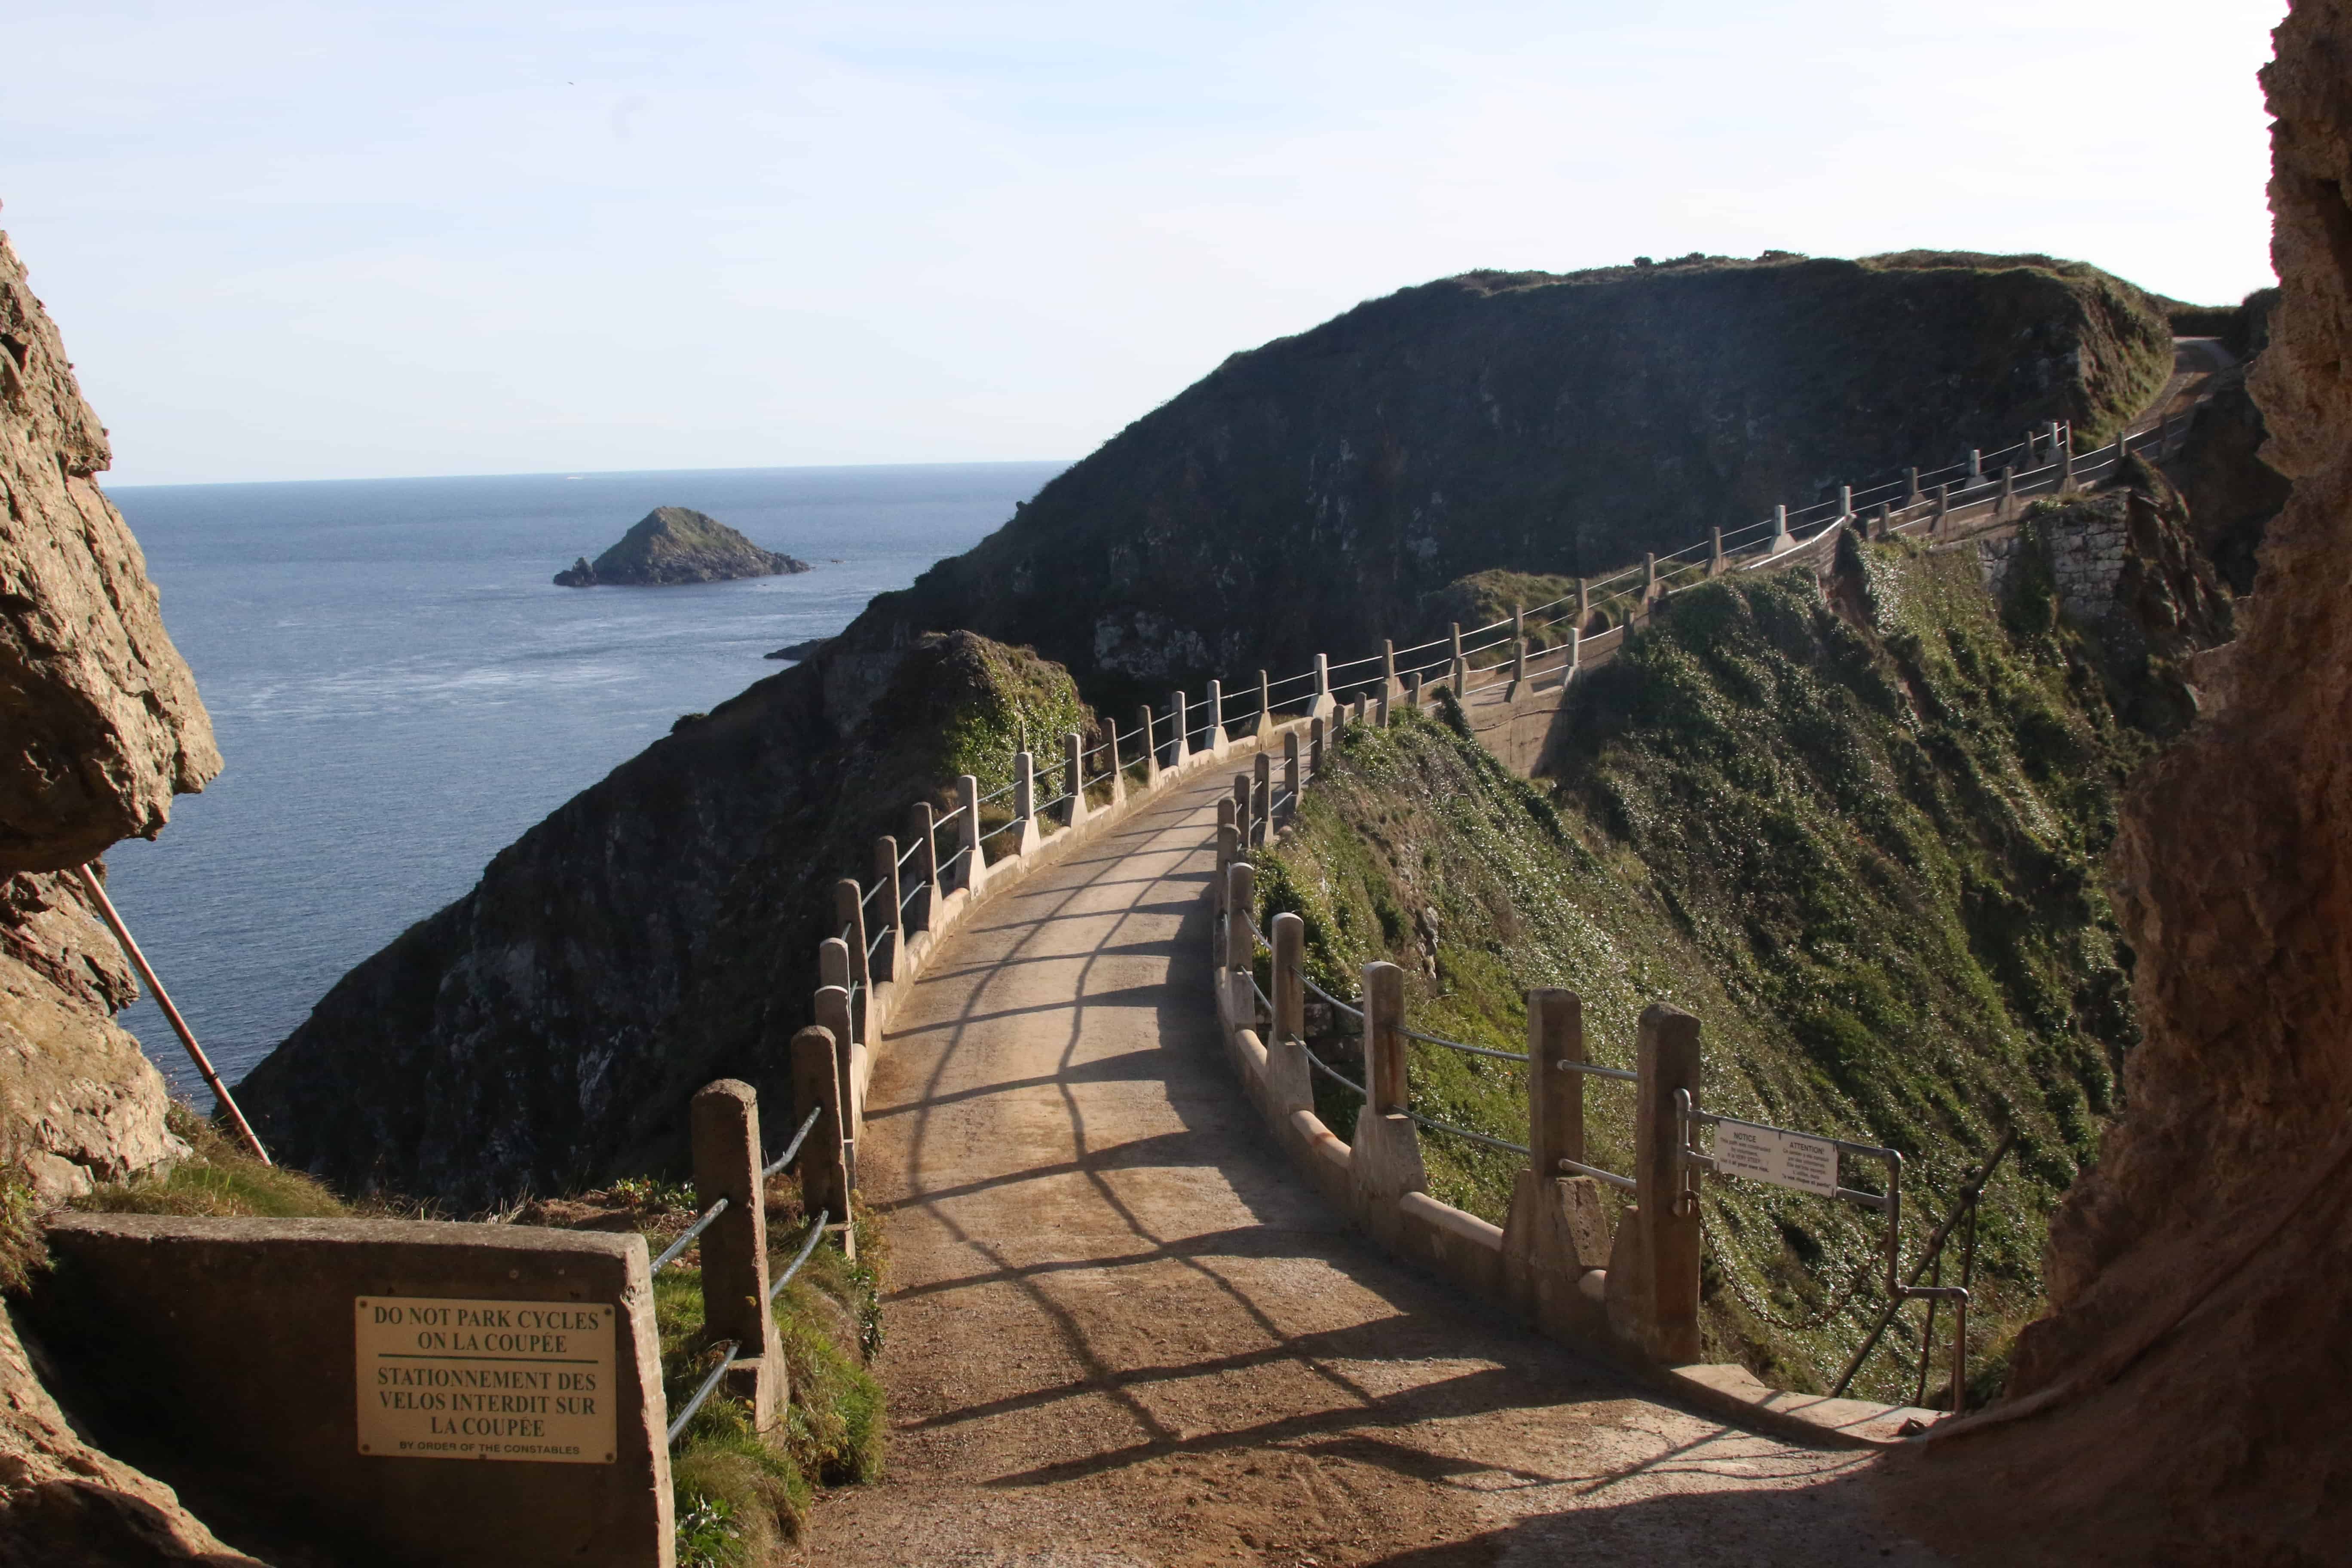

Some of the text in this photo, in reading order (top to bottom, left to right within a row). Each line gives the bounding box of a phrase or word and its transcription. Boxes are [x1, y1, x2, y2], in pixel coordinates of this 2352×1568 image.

[1734, 1132, 1756, 1142] NOTICE
[374, 1306, 599, 1330] DO NOT PARK CYCLES
[418, 1332, 567, 1353] ON LA COUPÉE
[377, 1367, 596, 1391] STATIONNEMENT DES
[379, 1390, 596, 1415] VELOS INTERDIT SUR
[431, 1416, 545, 1437] LA COUPÉE
[399, 1441, 580, 1455] BY ORDER OF THE CONSTABLES
